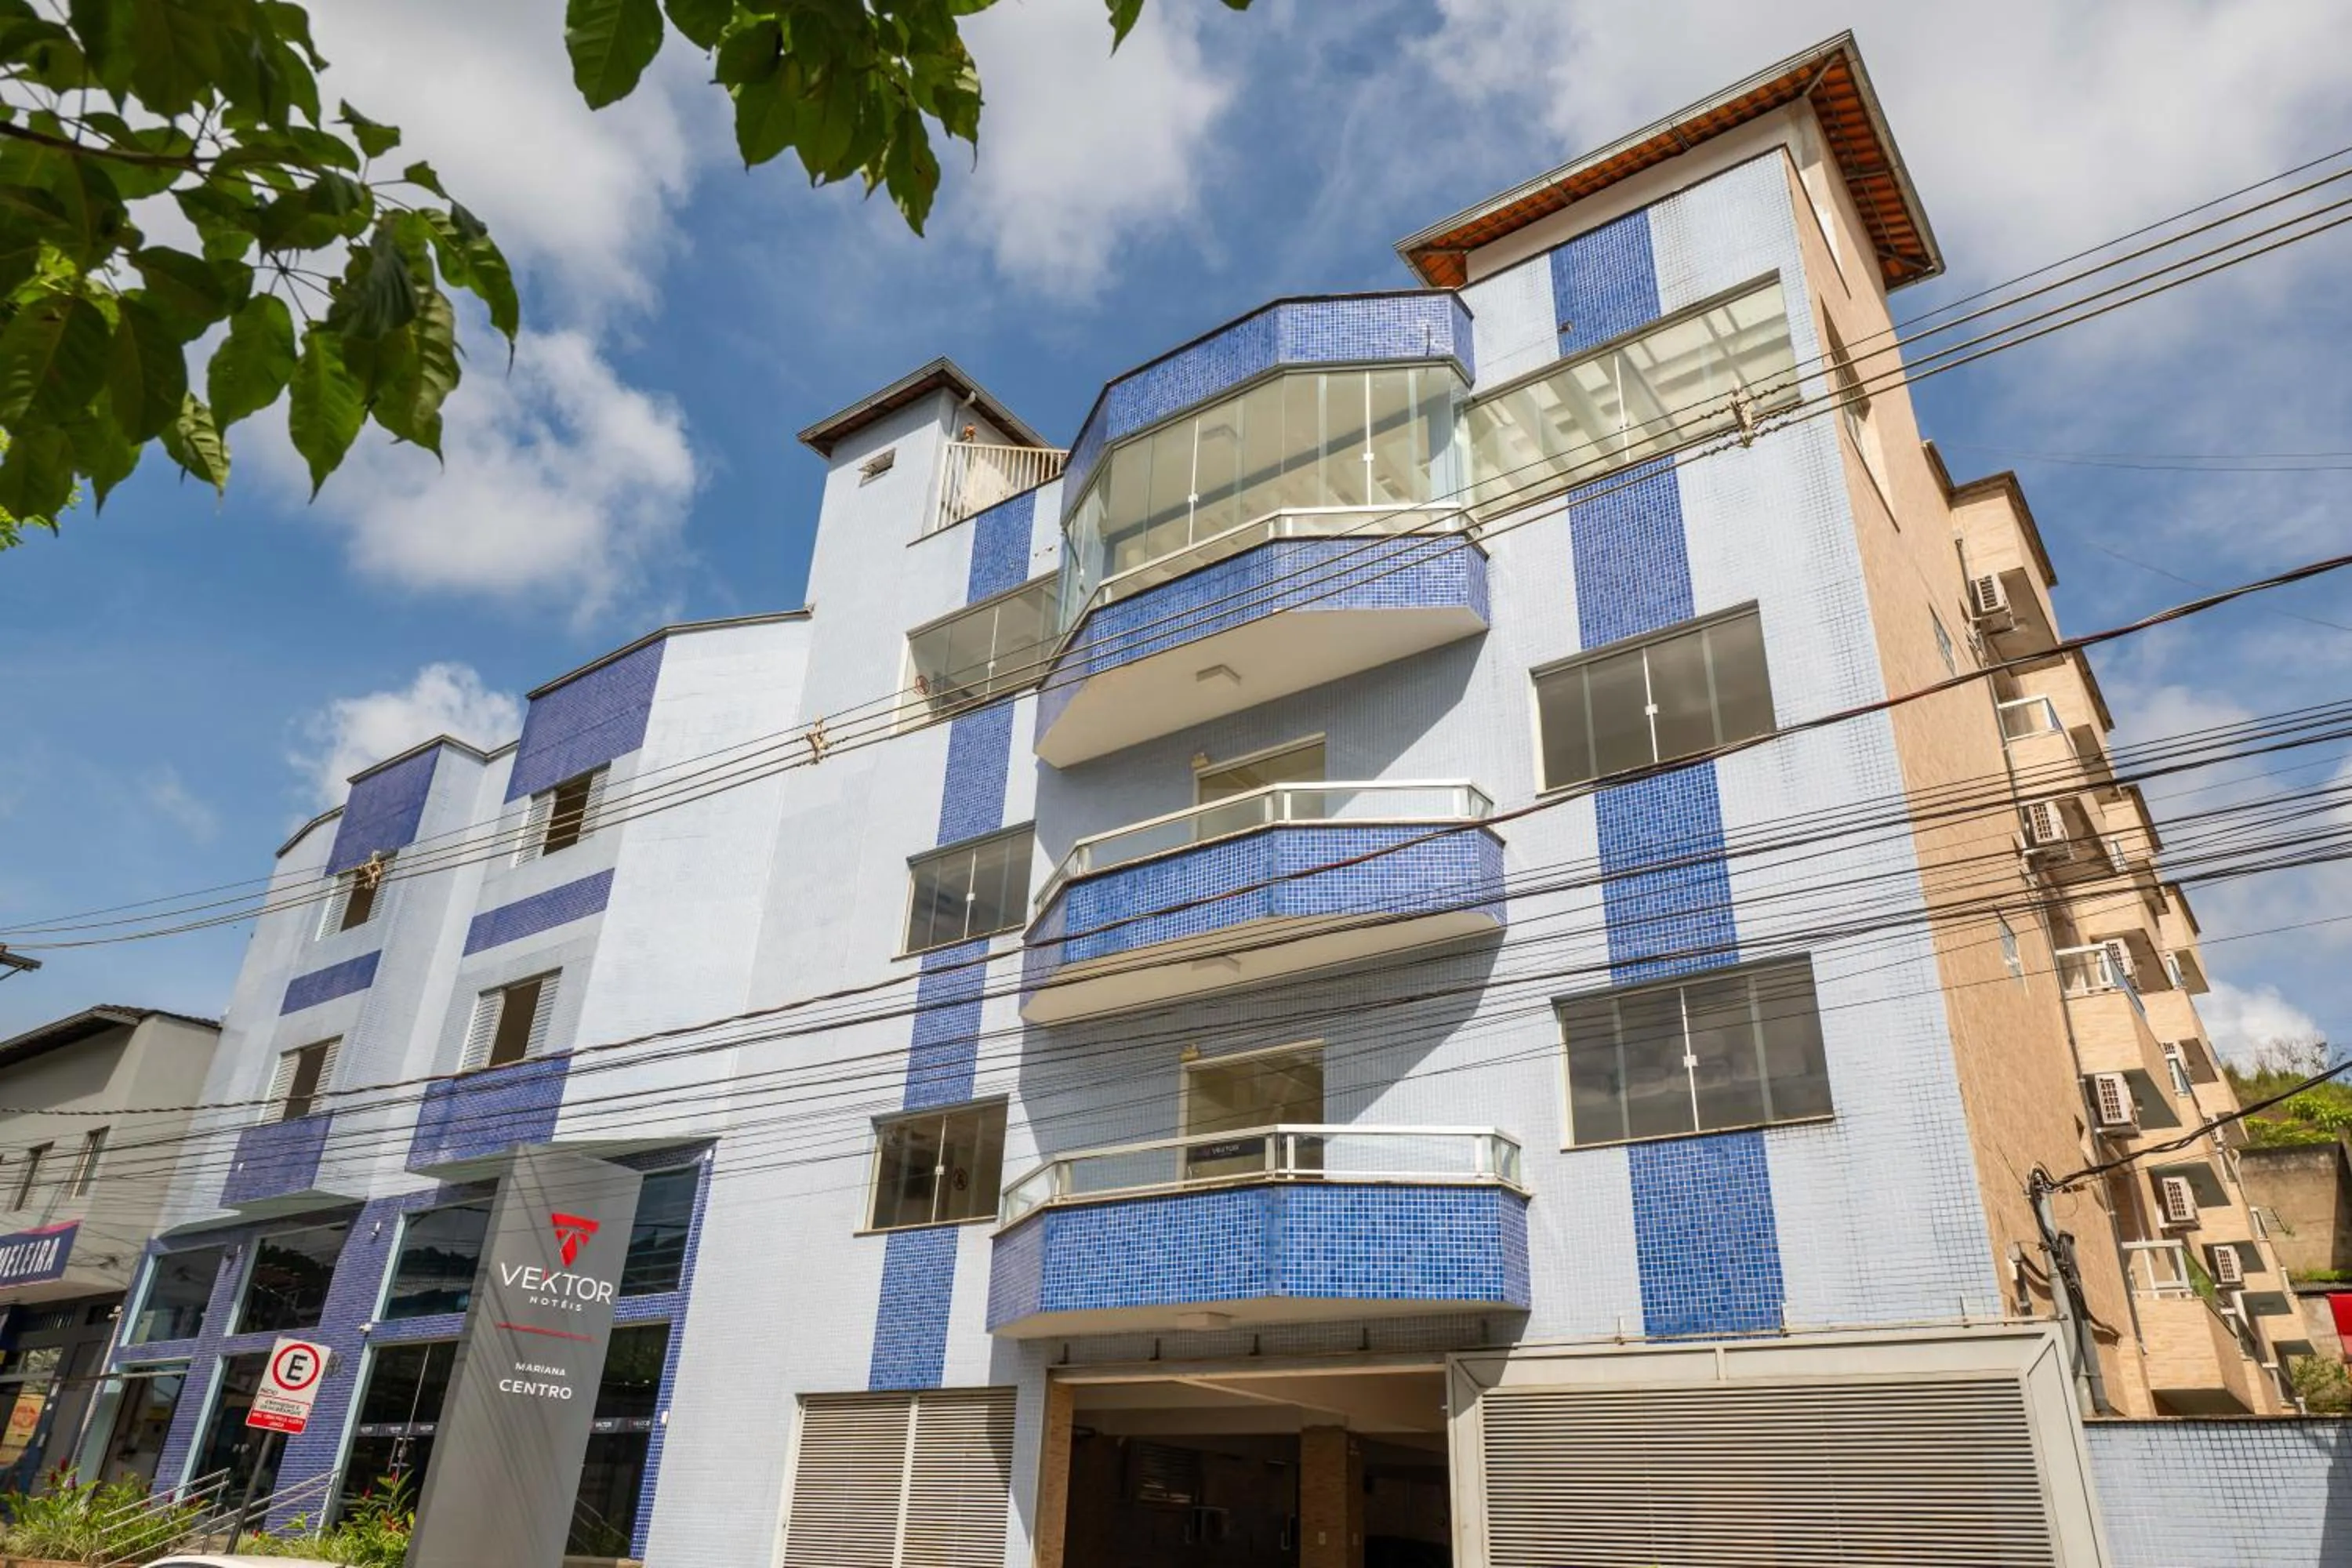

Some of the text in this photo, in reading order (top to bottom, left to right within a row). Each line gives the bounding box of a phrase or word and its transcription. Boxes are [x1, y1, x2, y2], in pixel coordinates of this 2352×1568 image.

[501, 1262, 613, 1305] VEKTOR
[286, 1354, 308, 1381] E
[515, 1362, 565, 1376] MARIANA
[499, 1379, 572, 1399] CENTRO
